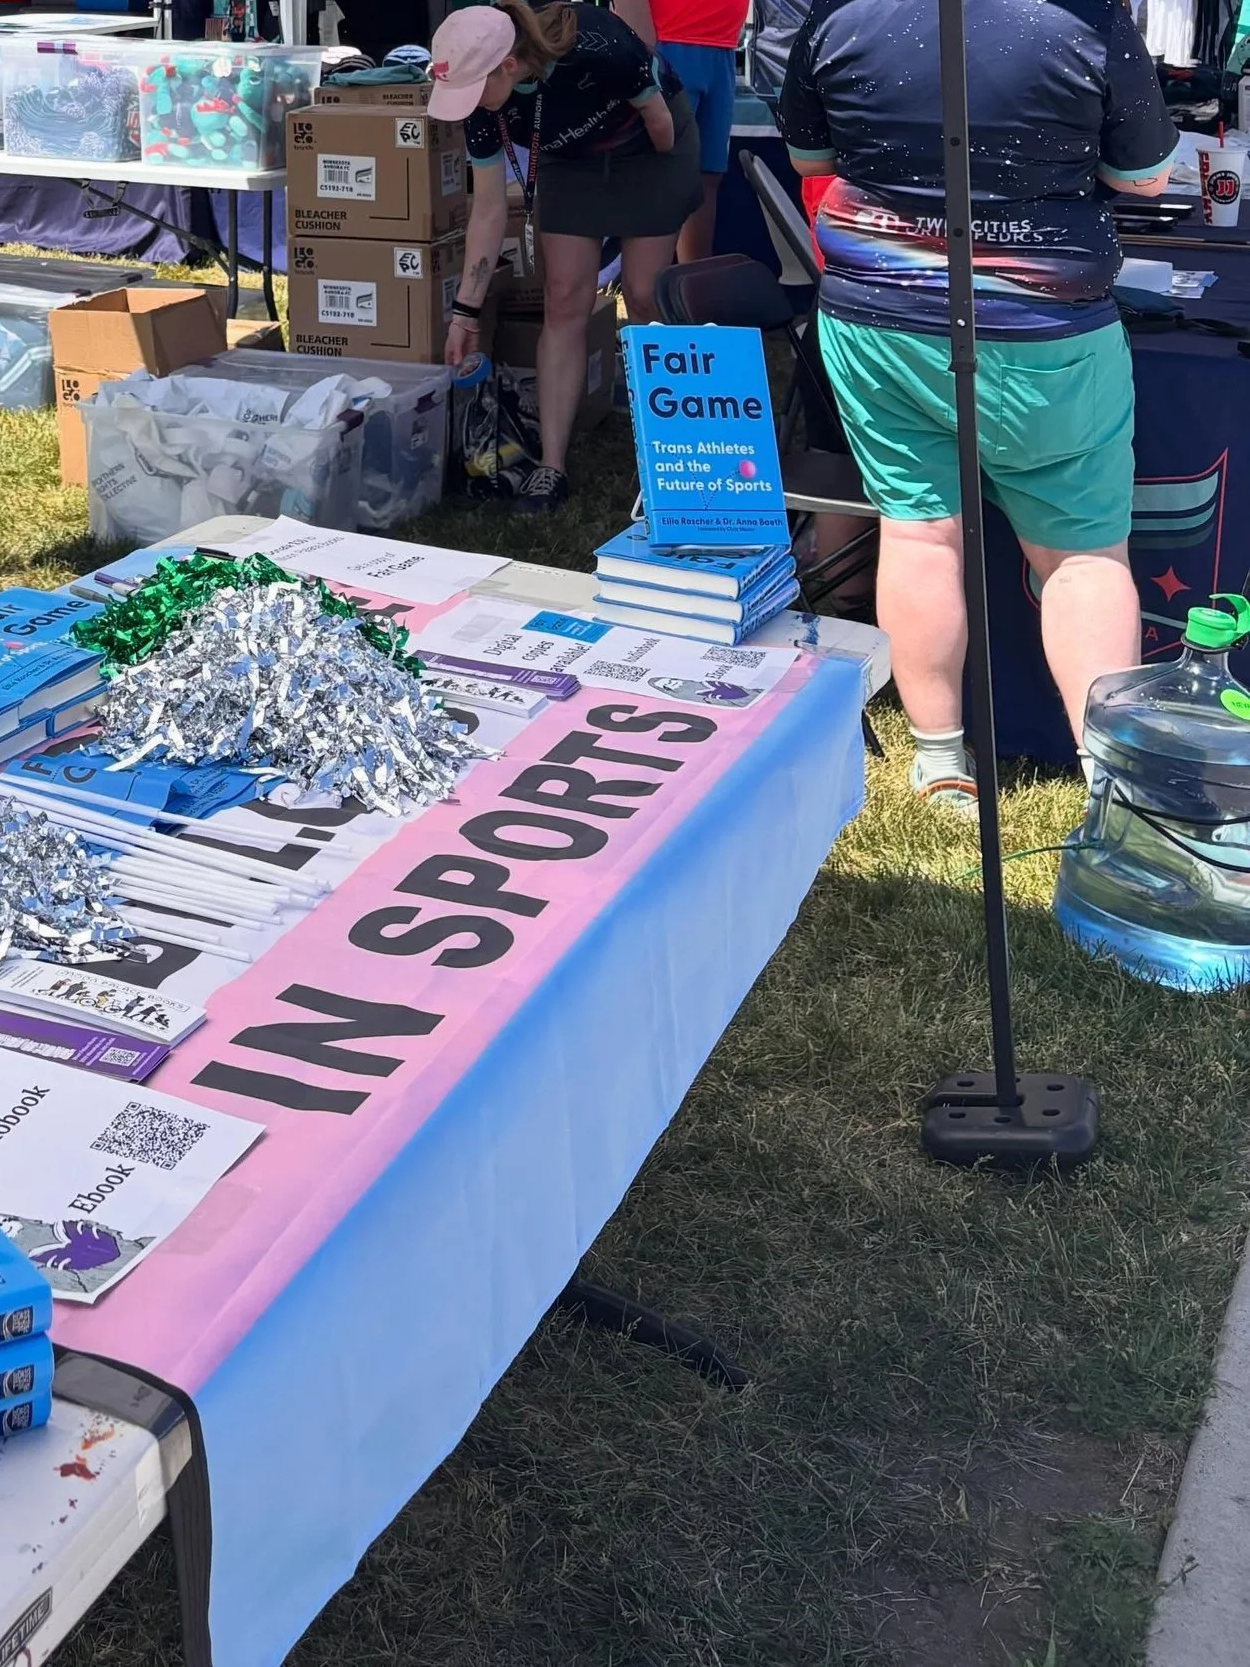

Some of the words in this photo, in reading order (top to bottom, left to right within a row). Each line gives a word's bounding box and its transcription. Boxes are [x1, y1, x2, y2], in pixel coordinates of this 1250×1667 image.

[294, 209, 347, 220] BLEACHER
[295, 220, 341, 231] CUSHION
[971, 219, 1031, 233] CITIES
[295, 333, 348, 346] BLEACHER
[296, 345, 342, 357] CUSHION
[642, 342, 717, 375] Fair
[648, 386, 763, 420] Game
[652, 441, 693, 454] Trans
[697, 442, 755, 455] Athletes
[655, 460, 684, 473] and
[687, 460, 711, 473] the
[657, 478, 704, 491] Future
[708, 478, 723, 491] of
[726, 478, 773, 494] Sports
[3, 598, 89, 637] Game
[483, 633, 523, 656] Digital
[521, 640, 554, 661] copies
[1, 654, 14, 663] of
[550, 642, 593, 672] available!
[190, 983, 446, 1115] IN
[348, 704, 718, 968] SPORTS
[147, 993, 186, 1010] BOOKS
[68, 1163, 135, 1214] Ebook
